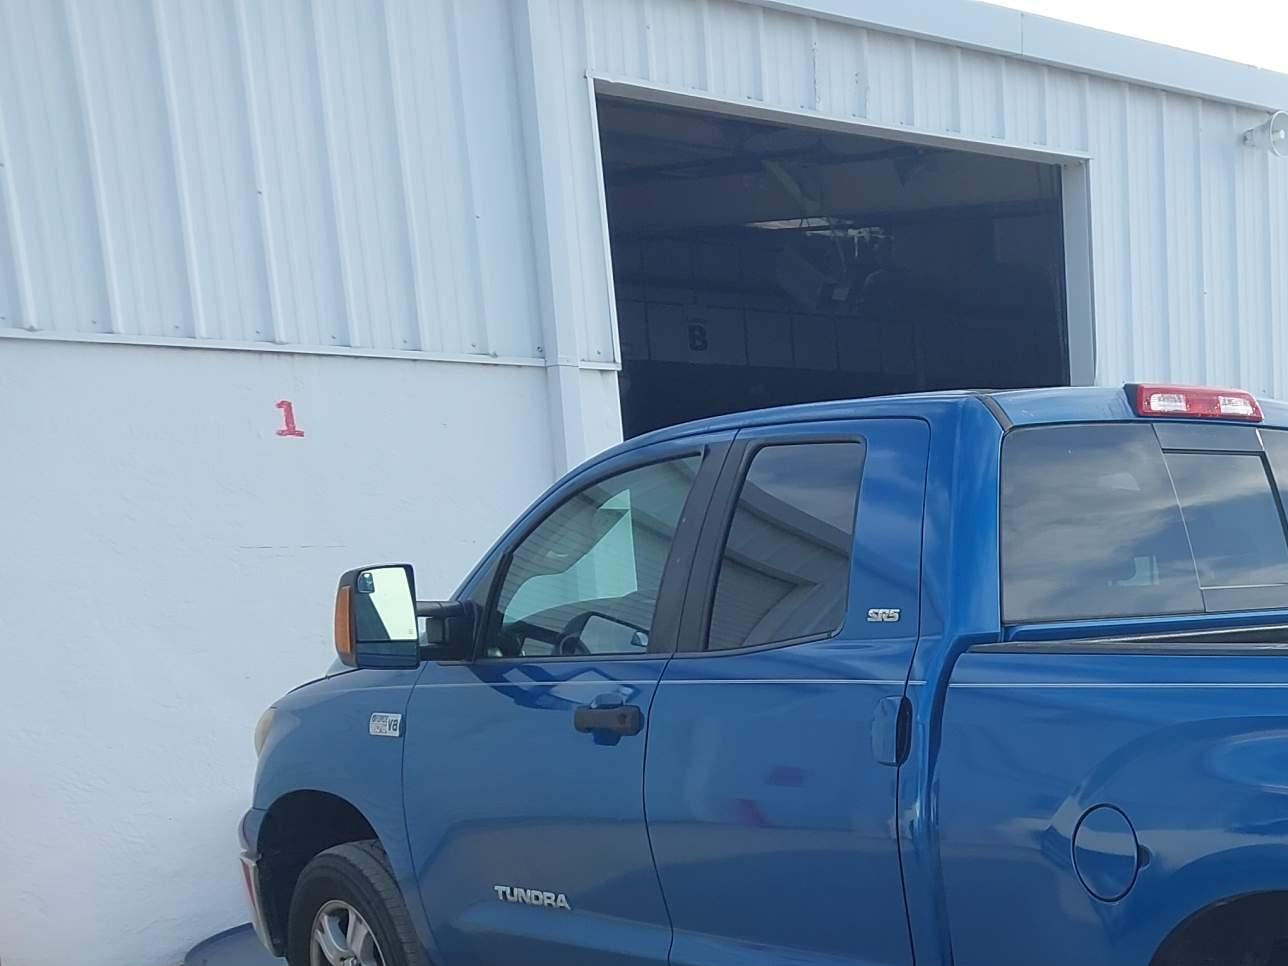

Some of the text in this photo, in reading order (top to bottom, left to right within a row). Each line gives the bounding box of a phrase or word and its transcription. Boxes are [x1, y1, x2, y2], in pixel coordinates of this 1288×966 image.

[276, 400, 305, 437] 1
[867, 608, 900, 622] SR5
[494, 885, 571, 911] TUNDRA
